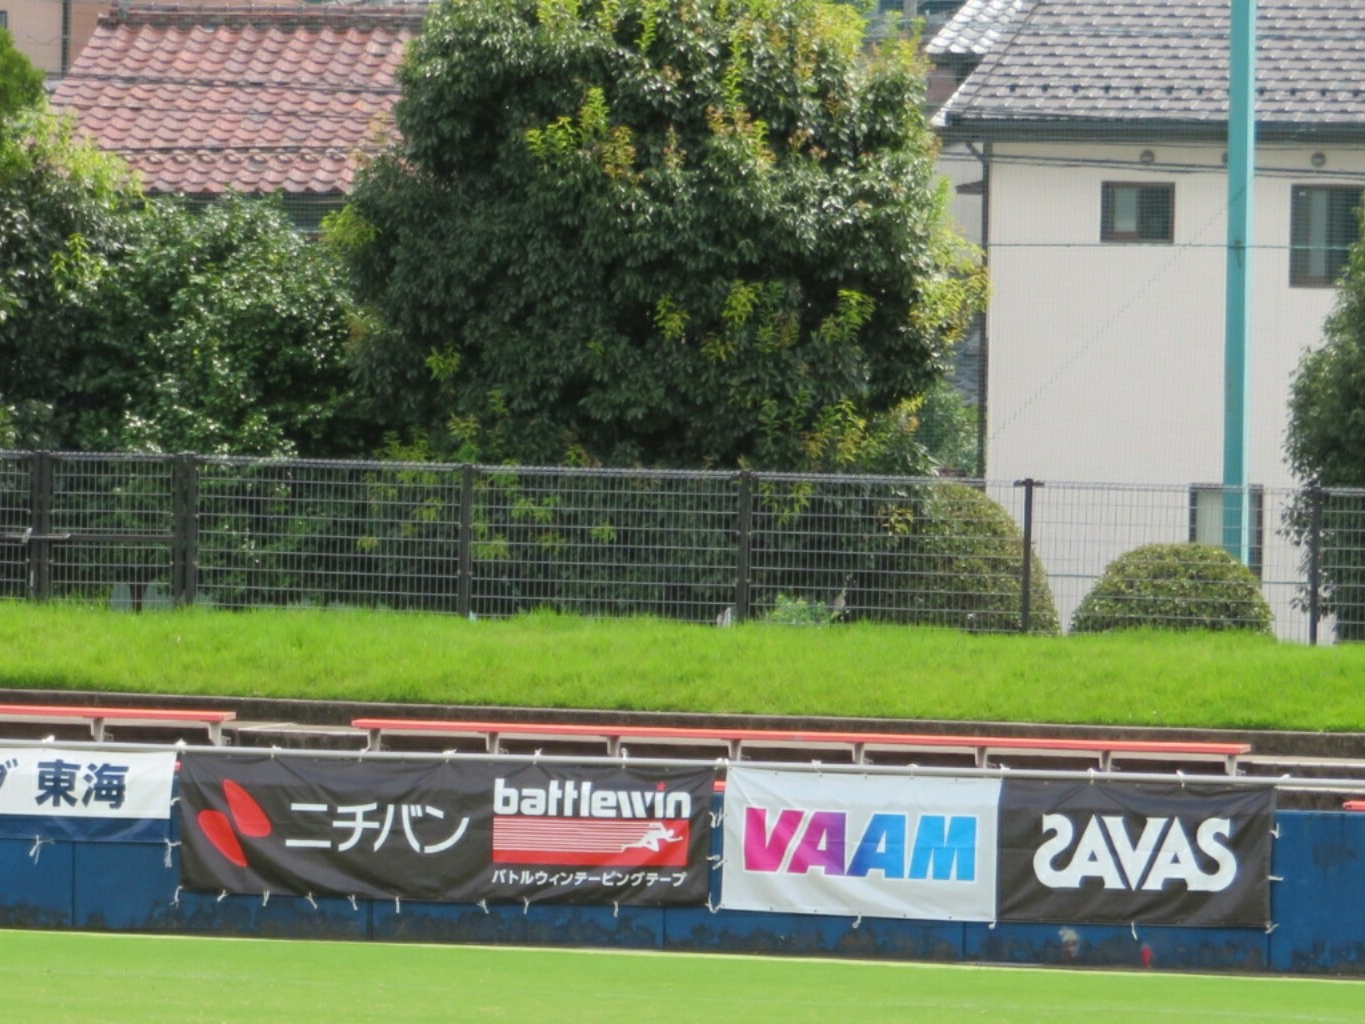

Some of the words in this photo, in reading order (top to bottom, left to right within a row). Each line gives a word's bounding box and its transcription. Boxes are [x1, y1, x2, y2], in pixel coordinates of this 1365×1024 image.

[35, 757, 131, 810] 東海
[493, 778, 692, 819] battlewin
[285, 802, 471, 855] ニチバン
[742, 805, 979, 883] VAAM
[1032, 812, 1239, 894] SAVAS
[491, 868, 689, 888] バトルウィンテーピングテープ
